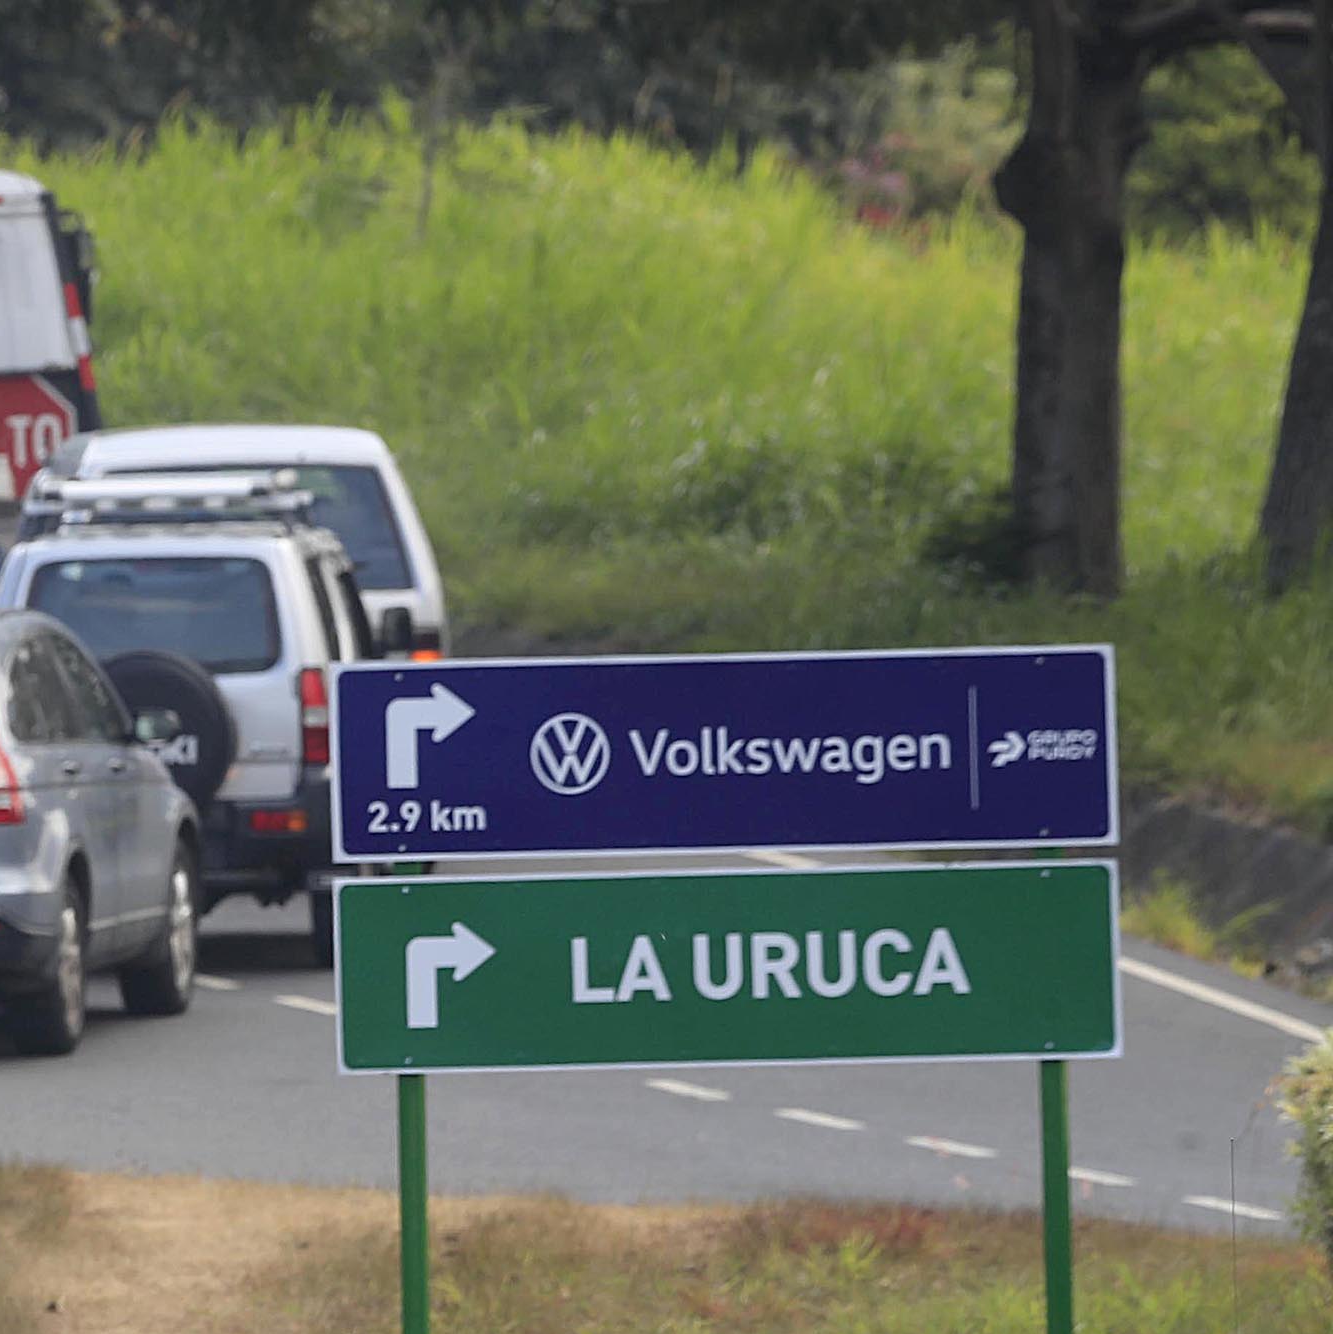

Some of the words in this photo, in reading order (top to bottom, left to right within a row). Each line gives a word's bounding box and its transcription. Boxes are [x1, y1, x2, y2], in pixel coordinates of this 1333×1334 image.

[628, 725, 952, 784] Volkswagen
[367, 800, 422, 833] 2.9
[430, 799, 488, 832] km
[570, 934, 672, 1004] LA
[692, 927, 972, 1002] URUCA
